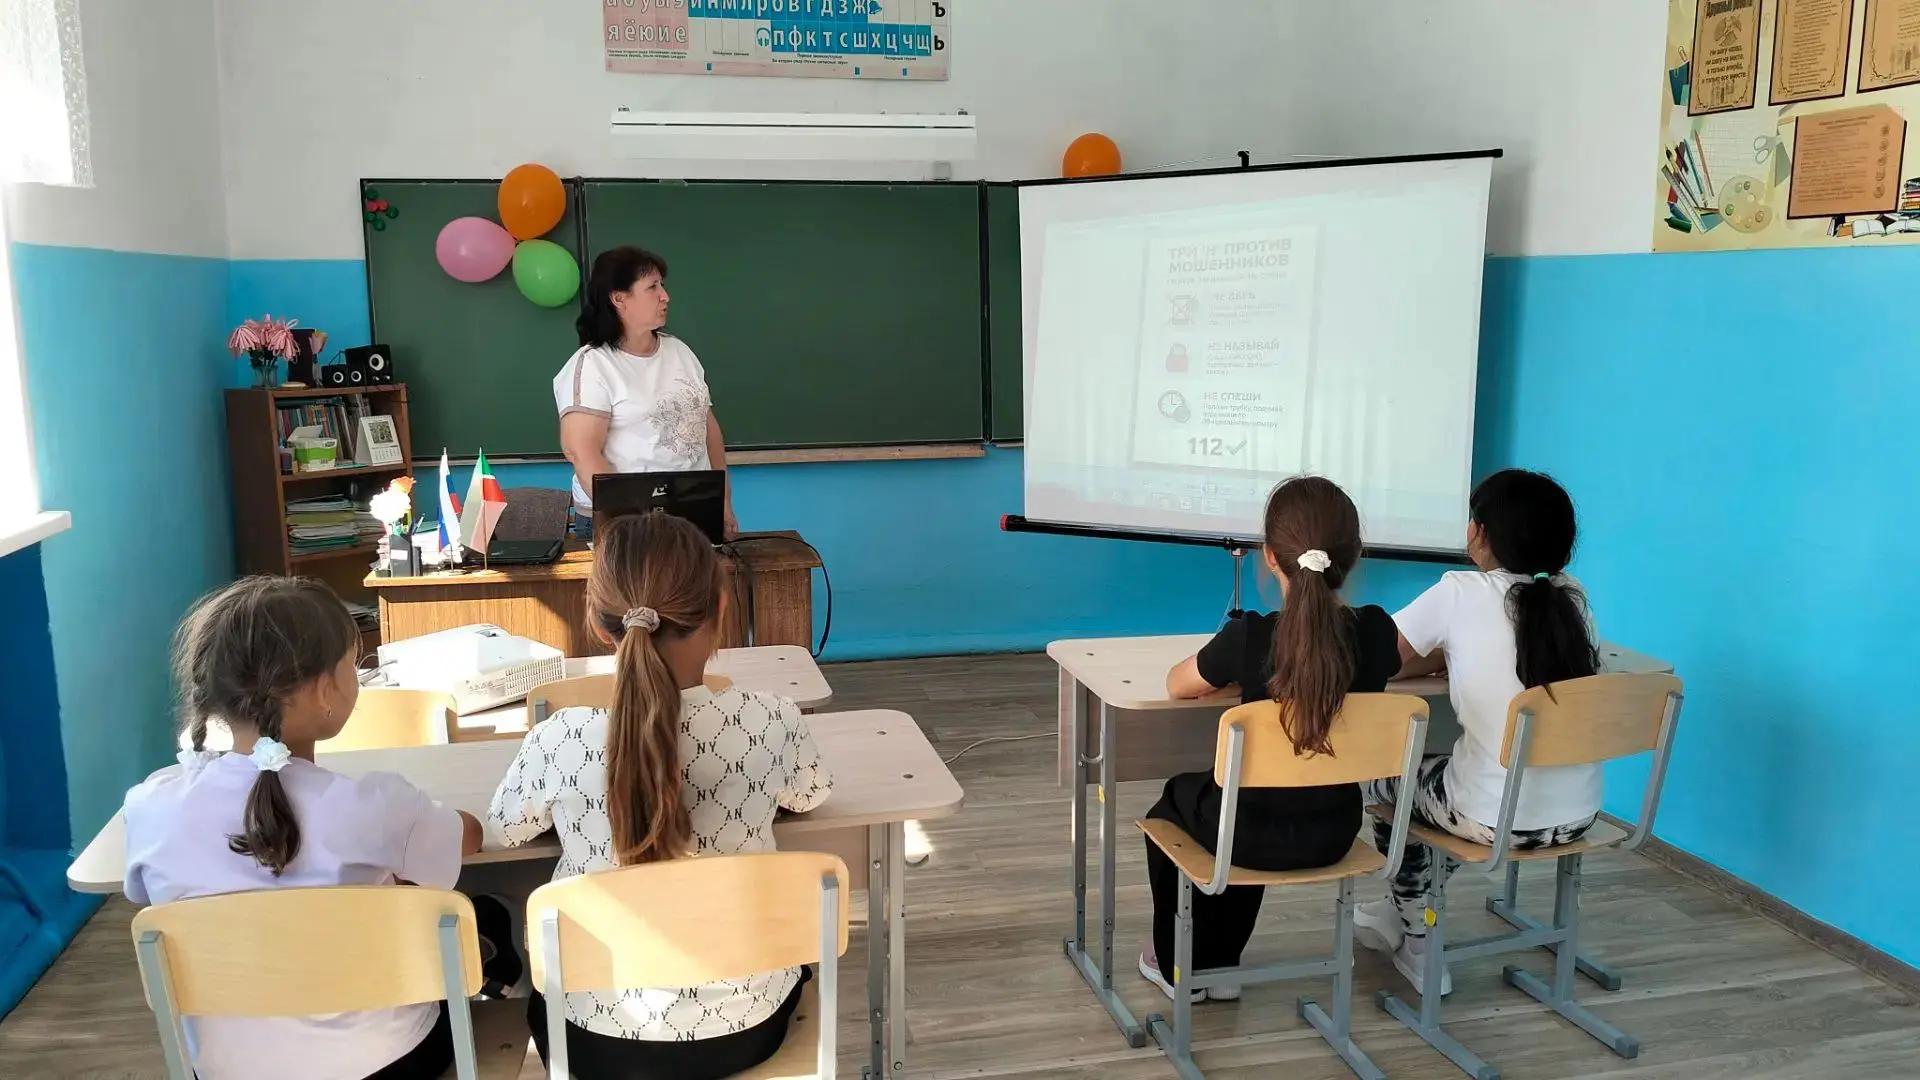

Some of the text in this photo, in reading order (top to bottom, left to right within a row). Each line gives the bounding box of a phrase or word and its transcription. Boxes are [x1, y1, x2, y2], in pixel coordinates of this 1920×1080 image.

[1224, 238, 1292, 255] ПРОТИВ
[1168, 253, 1290, 274] МОШЕННИКОВ
[1224, 338, 1281, 351] НАЗЫВАЙ
[1221, 392, 1262, 401] СПЕШИ
[1188, 437, 1223, 456] 112
